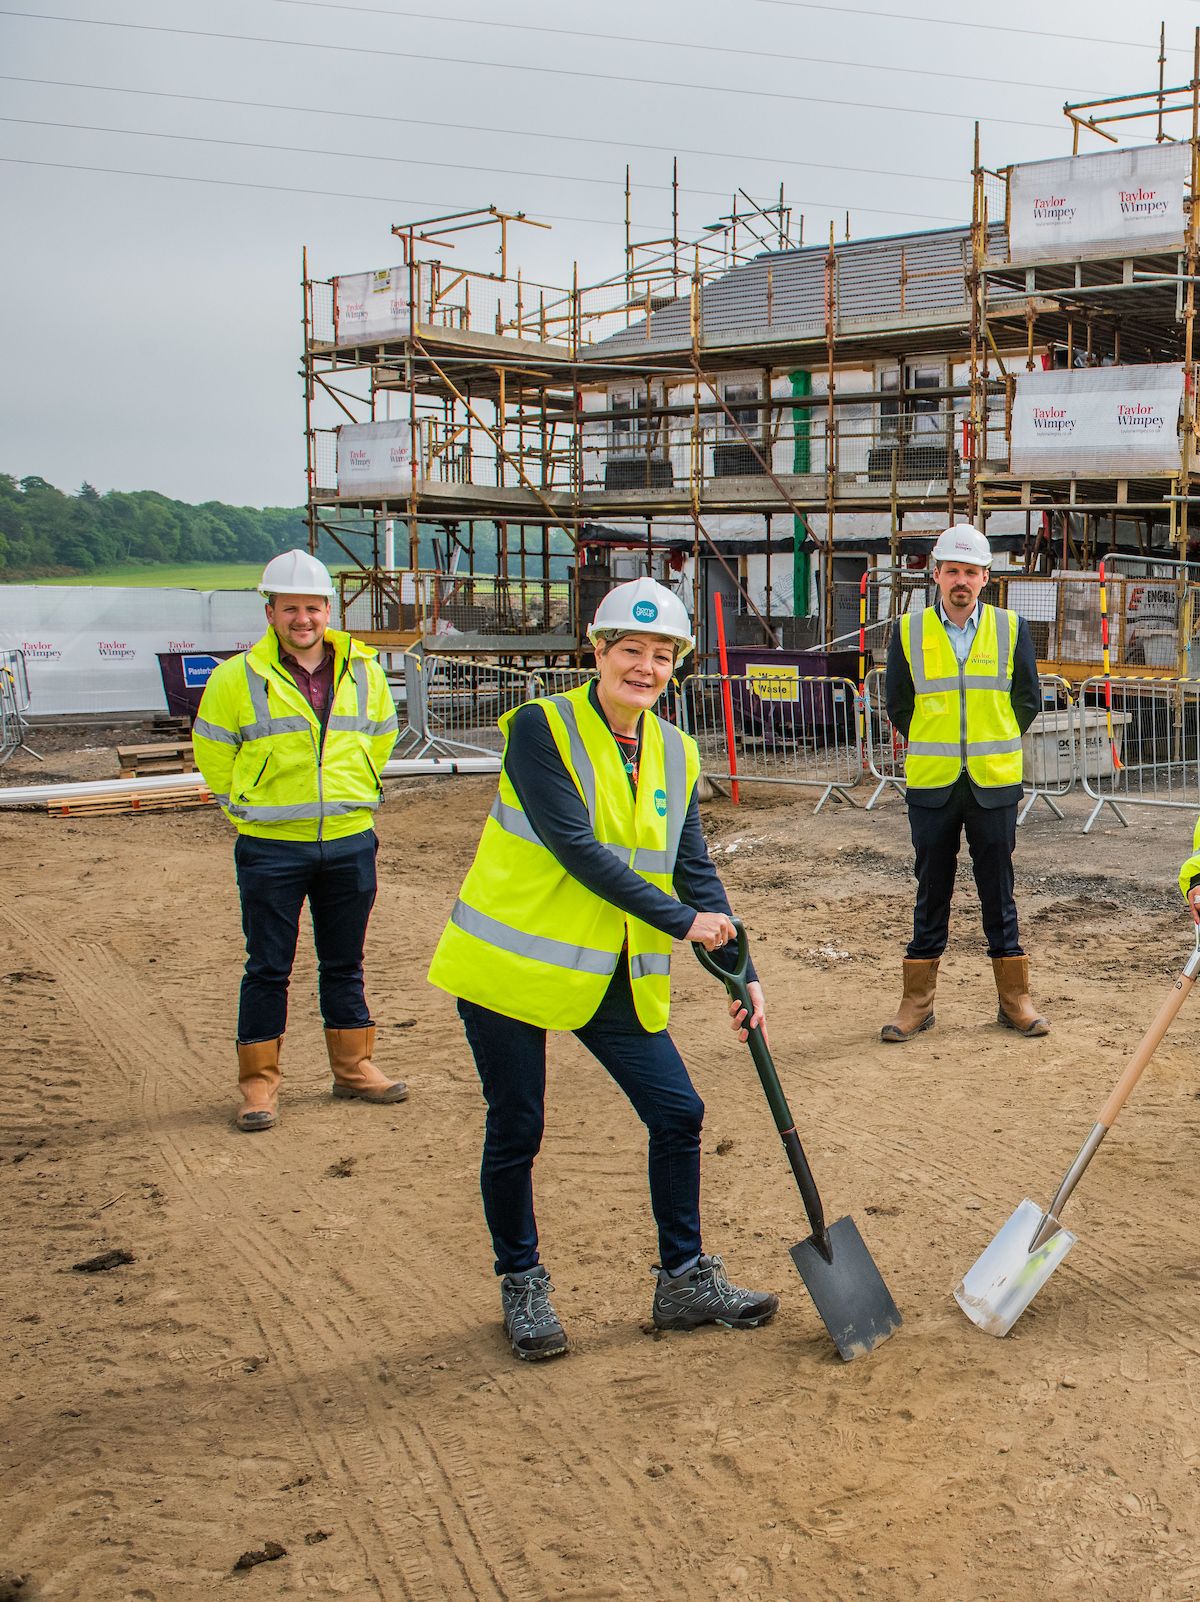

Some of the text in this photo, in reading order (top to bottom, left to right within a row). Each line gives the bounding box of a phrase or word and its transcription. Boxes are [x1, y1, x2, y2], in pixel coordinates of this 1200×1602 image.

[1118, 188, 1156, 203] Taylor
[1033, 196, 1066, 209] Taylor
[1120, 200, 1169, 213] Wimpey
[1033, 207, 1077, 220] Wimpey
[1032, 406, 1067, 418] Taylor
[1117, 402, 1154, 415] Taylor
[1033, 418, 1077, 431] Wimpey
[1117, 414, 1165, 428] Wimpey
[350, 449, 367, 458] Taylor
[350, 458, 371, 467] Wimpey
[636, 605, 655, 613] home
[636, 610, 655, 618] group
[21, 641, 53, 651] Taylor
[97, 641, 127, 651] Taylor
[167, 641, 196, 650] Taylor
[23, 648, 62, 659] Wimpey
[98, 649, 137, 659] Wimpey
[759, 685, 787, 694] Waste
